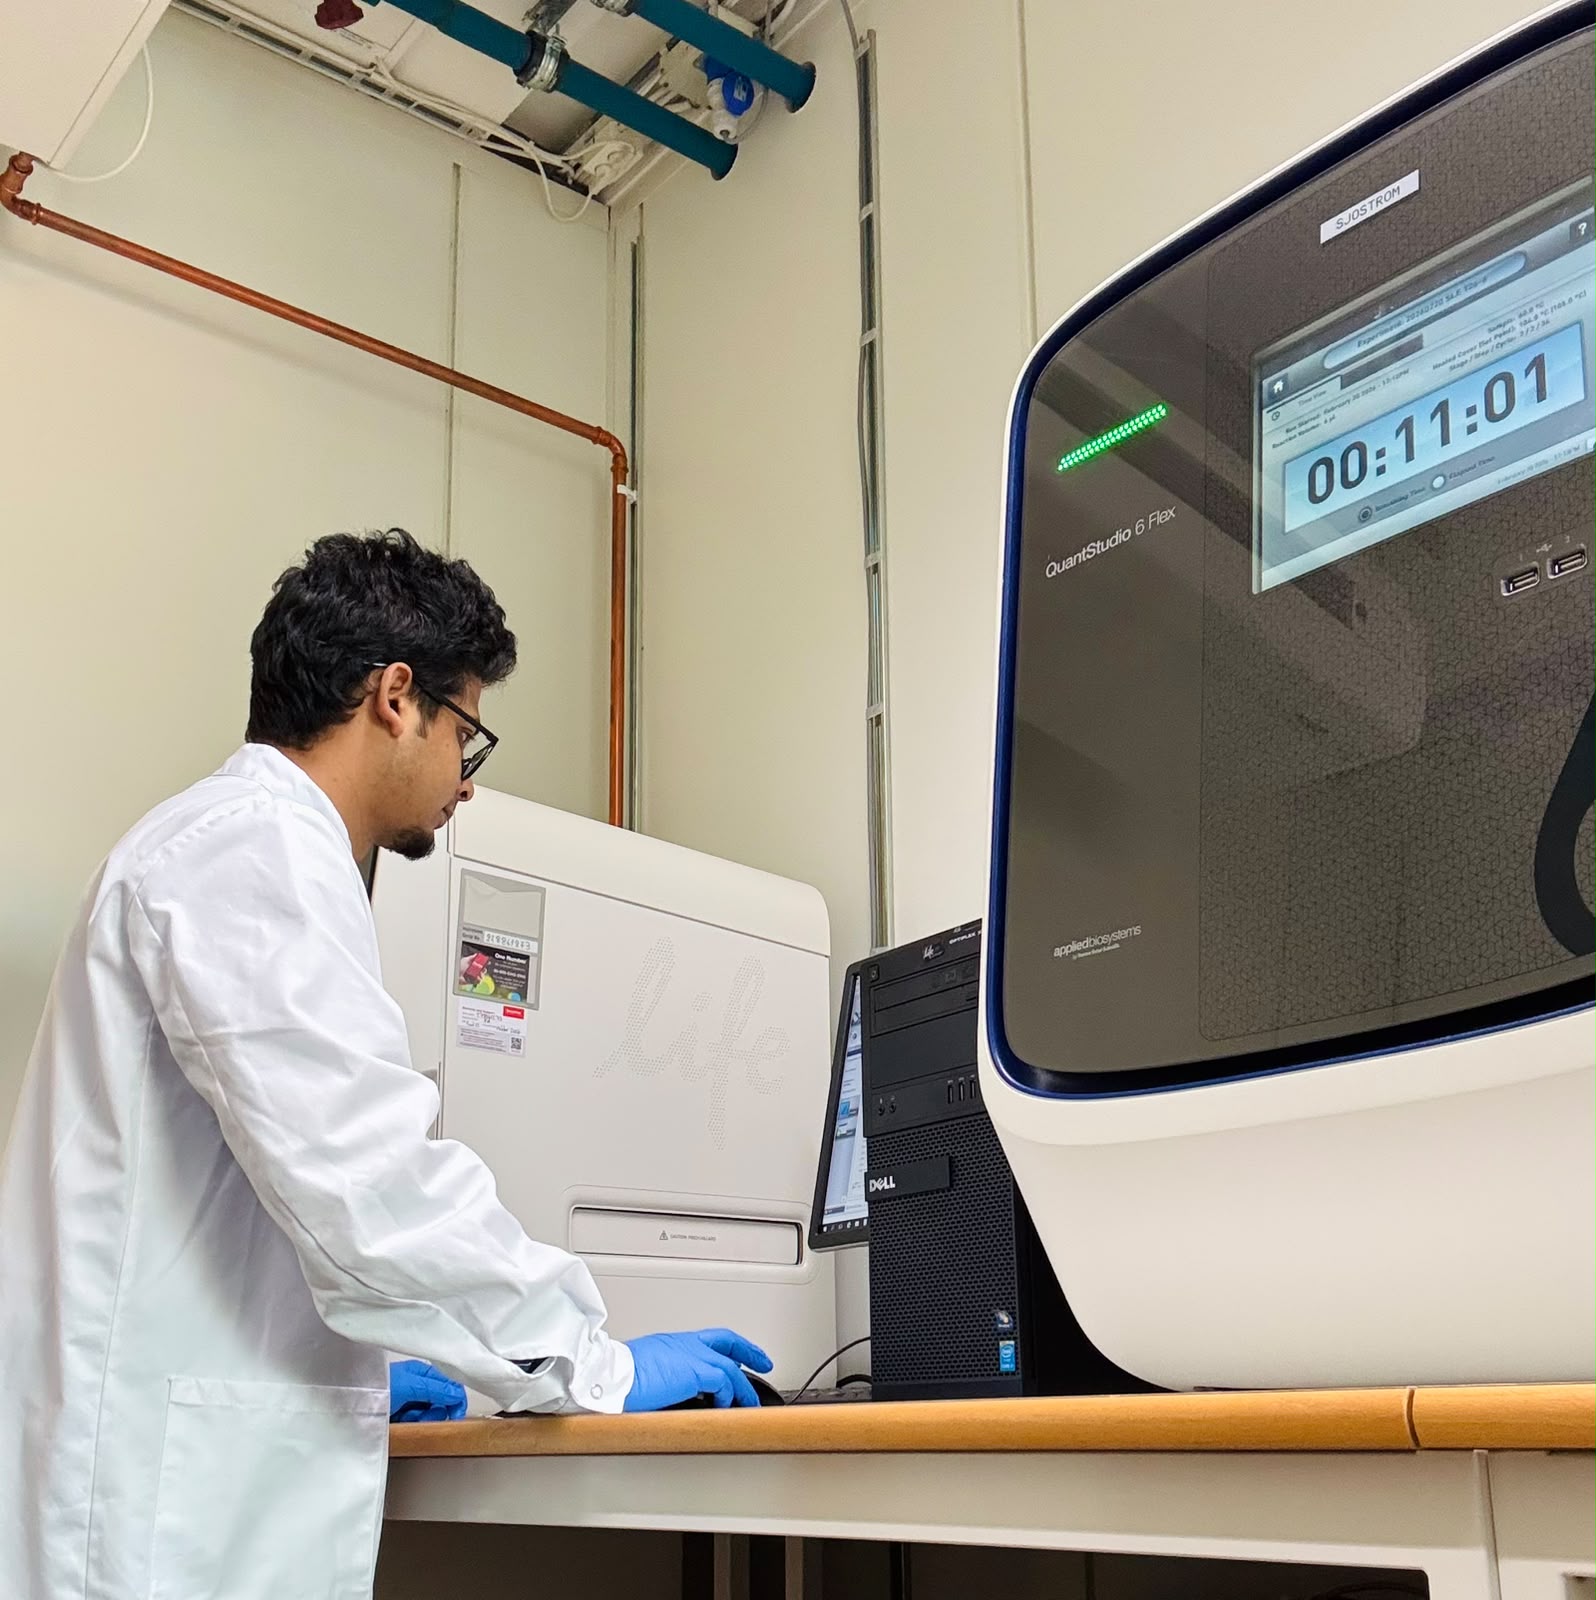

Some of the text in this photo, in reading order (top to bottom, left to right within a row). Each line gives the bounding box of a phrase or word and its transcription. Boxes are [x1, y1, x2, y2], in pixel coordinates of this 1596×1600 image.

[1335, 185, 1401, 230] SJOSTROM
[1308, 352, 1549, 505] 00:11:01
[1045, 506, 1177, 578] QuantStudio 6 Flex
[869, 1175, 896, 1193] DELL
